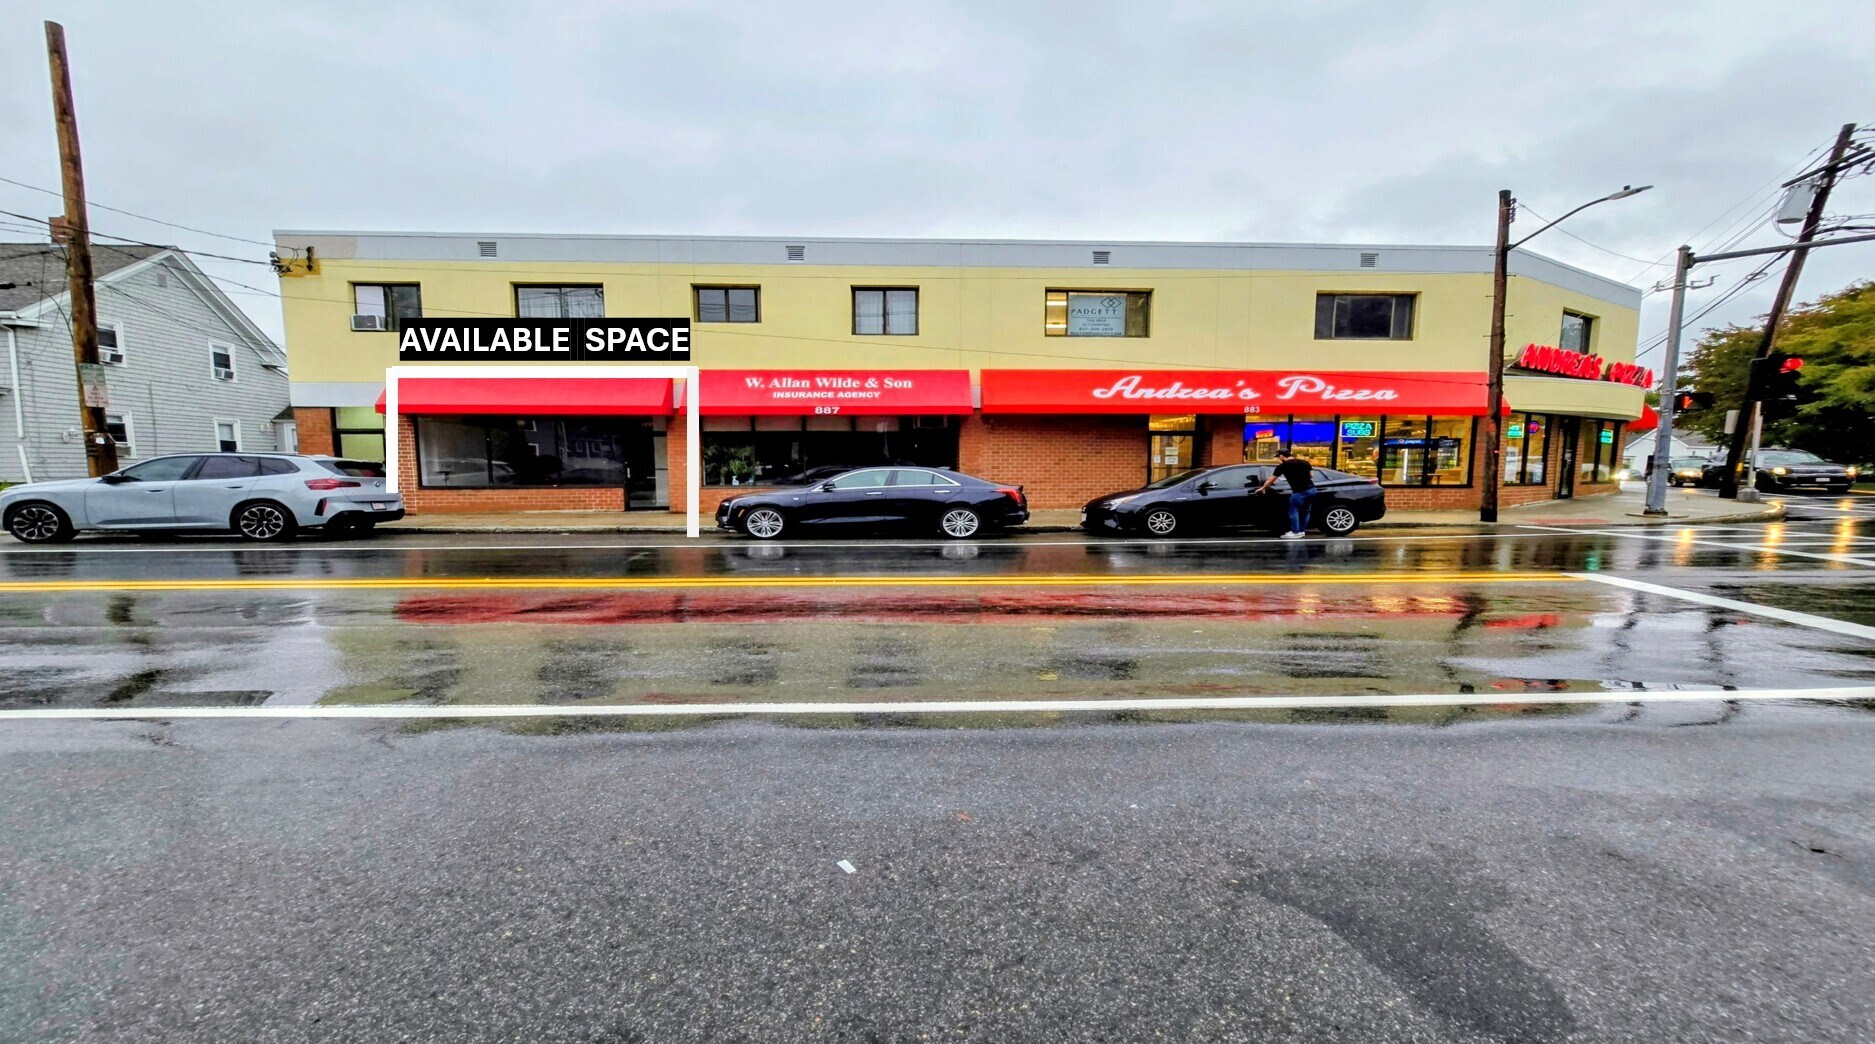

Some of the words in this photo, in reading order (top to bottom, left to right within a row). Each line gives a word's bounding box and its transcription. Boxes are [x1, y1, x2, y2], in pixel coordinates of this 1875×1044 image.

[1520, 342, 1604, 380] ANDREA'S
[1609, 362, 1654, 389] PIZZA
[744, 377, 765, 389] W.
[768, 377, 811, 388] Allan
[815, 377, 861, 388] Wilde
[864, 377, 880, 388] &
[883, 377, 913, 388] Son
[1092, 375, 1261, 400] Andrea's
[1276, 375, 1399, 401] Pizza
[773, 391, 835, 399] INSURANCE
[837, 391, 880, 399] AGENCY
[814, 406, 840, 415] 887
[1344, 422, 1373, 430] PIZZA
